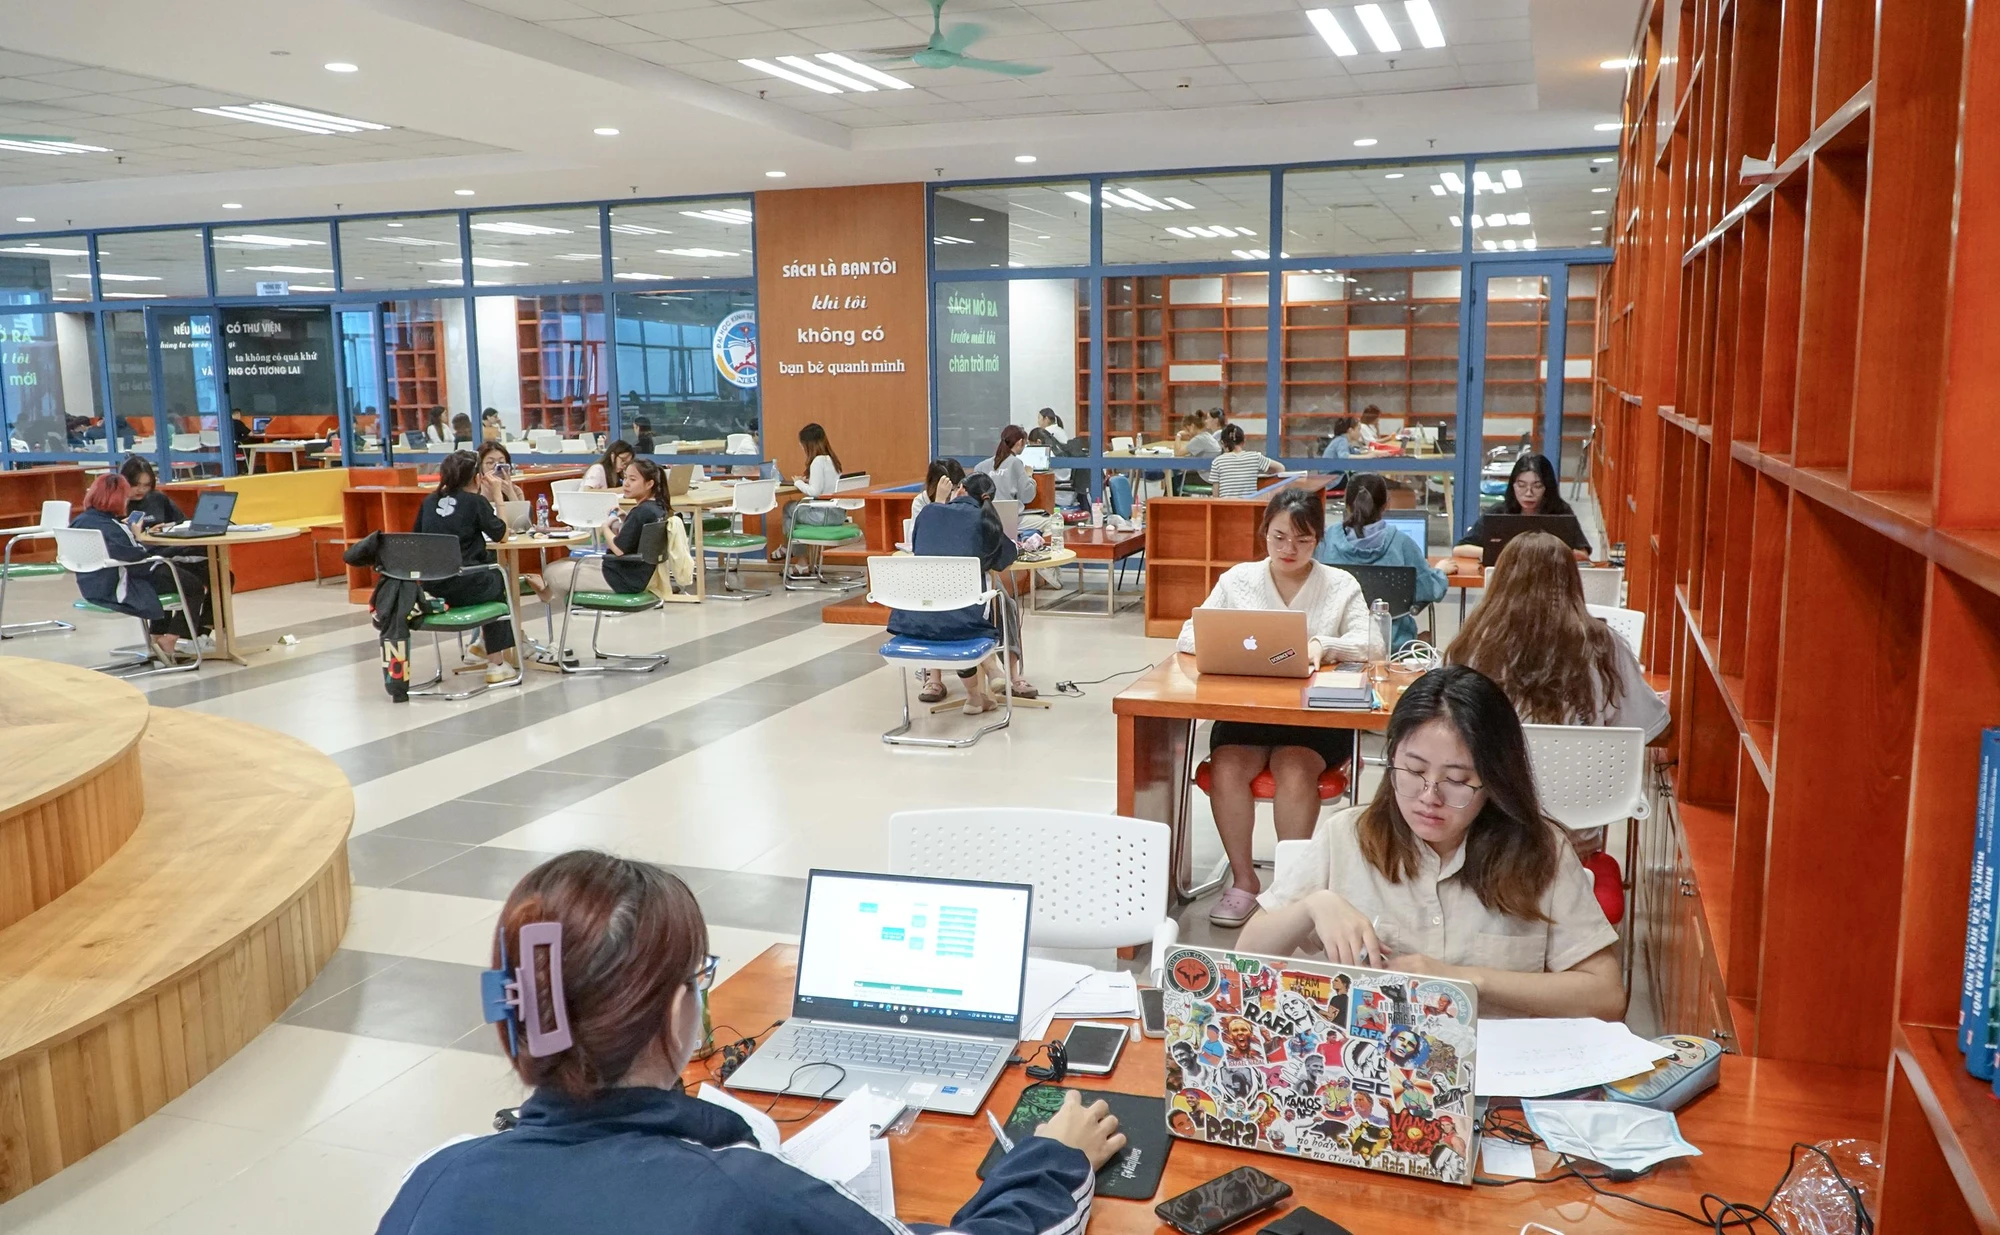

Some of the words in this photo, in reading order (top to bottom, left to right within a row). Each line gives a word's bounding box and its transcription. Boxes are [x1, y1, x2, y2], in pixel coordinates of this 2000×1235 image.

[782, 259, 816, 278] SÁCH
[820, 258, 837, 276] LÀ
[841, 261, 870, 279] BẠN
[872, 257, 897, 275] TÔI
[811, 294, 840, 310] khi
[844, 295, 868, 309] tôi
[947, 291, 971, 315] SÁCH
[973, 292, 986, 316] MỞ
[987, 300, 998, 317] RA
[173, 322, 190, 335] NẾU
[191, 324, 211, 335] KHÔ
[226, 322, 241, 334] CÓ
[243, 322, 261, 333] THƯ
[262, 321, 282, 334] VIỆN
[797, 326, 856, 346] không
[861, 325, 885, 341] có
[12, 330, 33, 344] RA
[160, 341, 178, 350] húng
[235, 354, 244, 362] ta
[245, 352, 271, 364] không
[272, 352, 282, 362] có
[282, 352, 299, 363] quá
[299, 351, 318, 361] khứ
[949, 354, 970, 373] chân
[971, 354, 985, 372] trời
[985, 354, 999, 372] mới
[244, 364, 257, 375] CÓ
[258, 365, 287, 375] TƯƠNG
[288, 365, 301, 375] LAI
[779, 361, 804, 377] bạn
[807, 360, 825, 373] bè
[827, 360, 870, 376] quanh
[871, 359, 905, 373] mình
[10, 372, 37, 386] mới
[1295, 975, 1320, 989] TEAM
[1244, 1002, 1294, 1036] RAFA
[1350, 1026, 1383, 1040] RAFA
[1206, 1113, 1258, 1147] Rafa
[1313, 1151, 1325, 1159] no
[1381, 1154, 1406, 1174] Rafa
